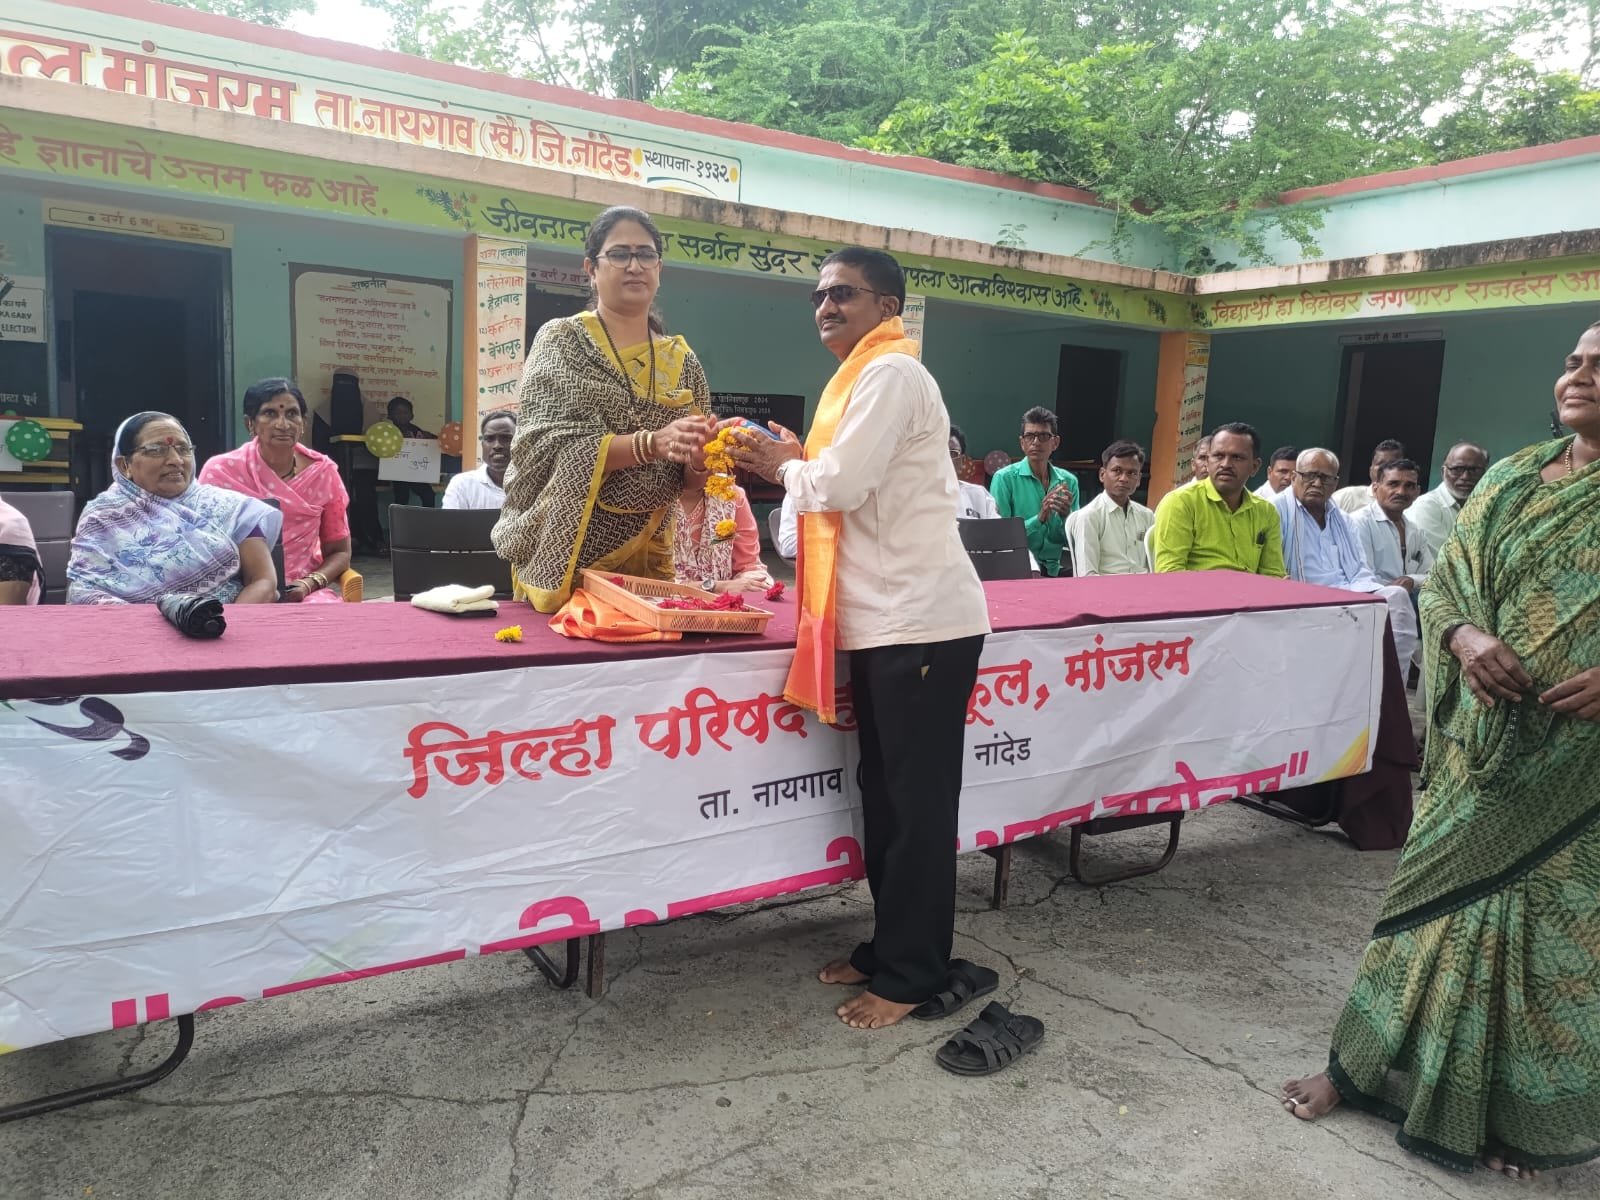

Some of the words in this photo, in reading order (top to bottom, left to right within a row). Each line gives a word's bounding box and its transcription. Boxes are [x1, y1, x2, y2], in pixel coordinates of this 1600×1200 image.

[33, 136, 155, 181] ज्ञानाचे
[160, 155, 253, 192] उत्तम
[260, 170, 315, 198] फळ
[678, 231, 746, 263] सर्वात
[748, 240, 809, 274] सुंदर
[947, 269, 1051, 307] आत्मविश्वास
[1211, 294, 1277, 324] विद्यार्थी
[1275, 298, 1294, 320] हा
[1365, 283, 1460, 311] जगणारा
[1464, 270, 1558, 305] राजहंस
[1560, 268, 1600, 295] आ
[403, 715, 616, 799] जिल्हा
[635, 687, 807, 760] परिषद
[1065, 634, 1193, 692] मांजरम
[698, 790, 738, 820] ता.
[753, 767, 843, 808] नायगाव
[974, 731, 1031, 767] नांदेड
